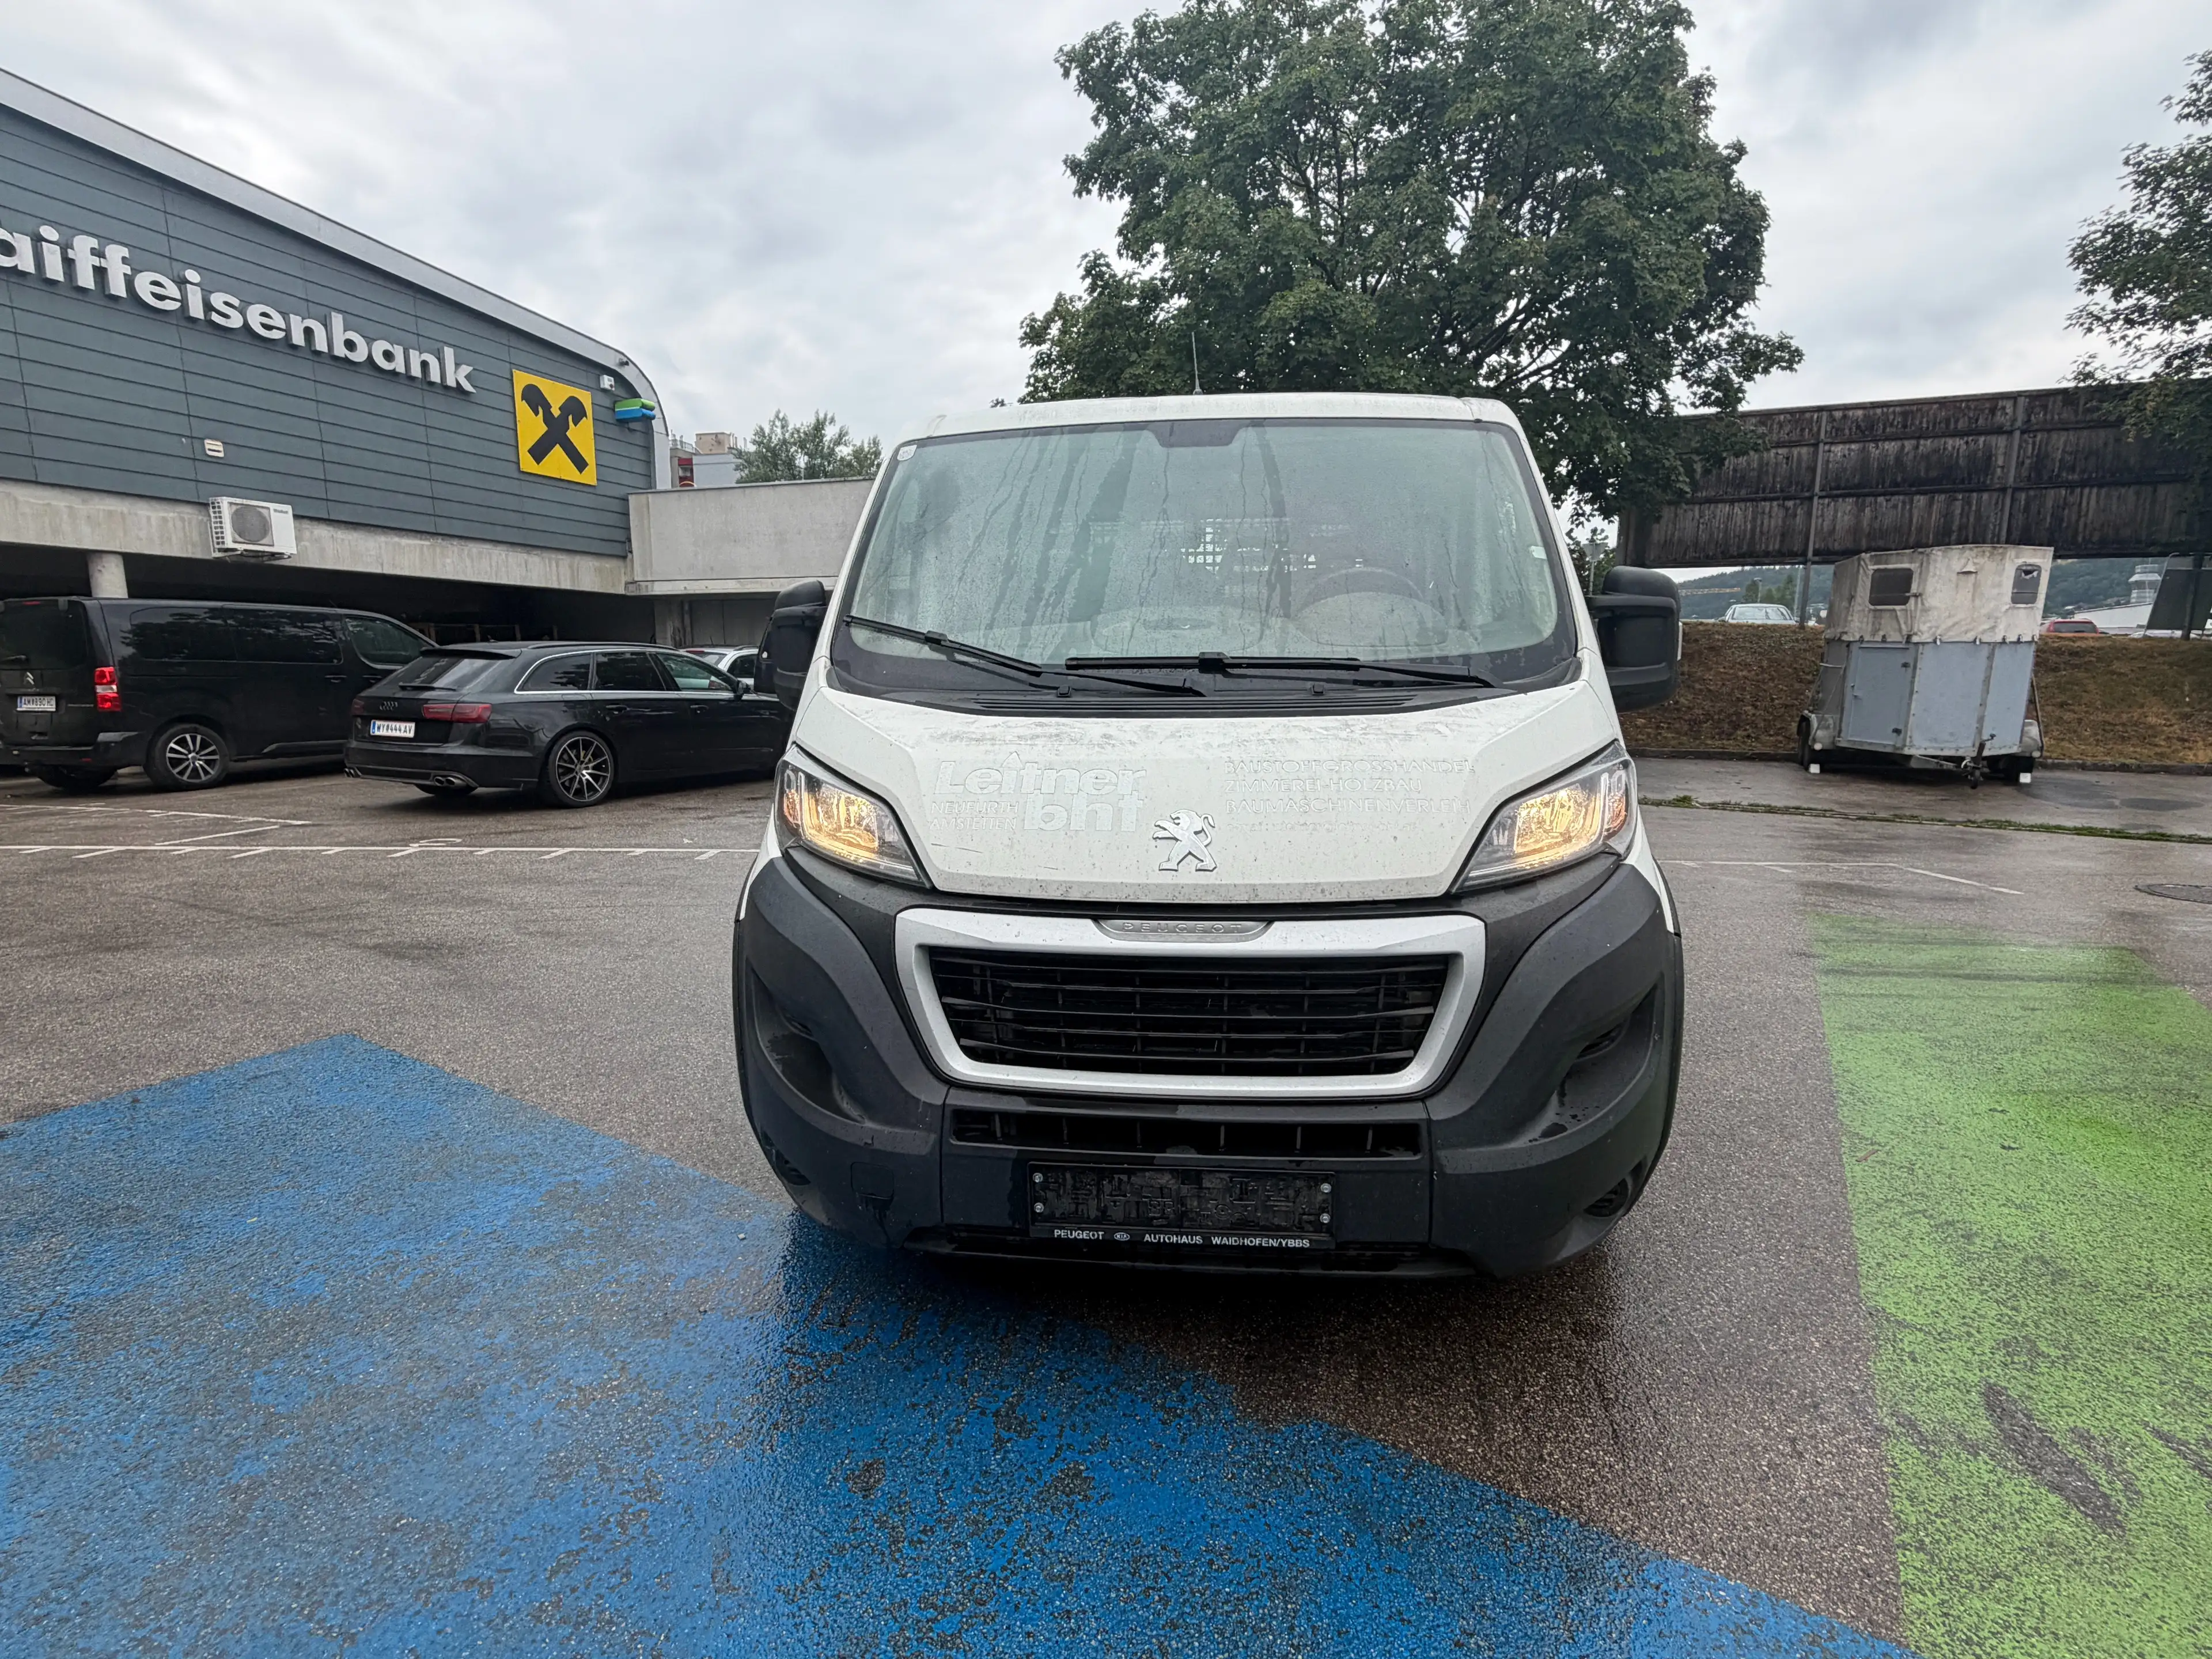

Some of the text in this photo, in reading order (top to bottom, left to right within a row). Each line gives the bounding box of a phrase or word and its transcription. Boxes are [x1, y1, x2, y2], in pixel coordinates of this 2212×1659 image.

[0, 225, 476, 393] aiffeisenbank
[933, 751, 1147, 796] Leitner
[1224, 759, 1475, 774] BAUSTOFFGROSSHANDEL
[931, 801, 1019, 814] NEUFURTH
[1226, 797, 1471, 814] BAUMASCHINENVERLEIH
[929, 817, 1017, 831] AMSTETTEN
[1123, 922, 1242, 933] PEUGEOT
[1054, 1229, 1104, 1240] PEUGEOT
[1143, 1233, 1203, 1244] AUTOHAUS
[1211, 1236, 1310, 1248] WAIDHOFEN/YBBS
